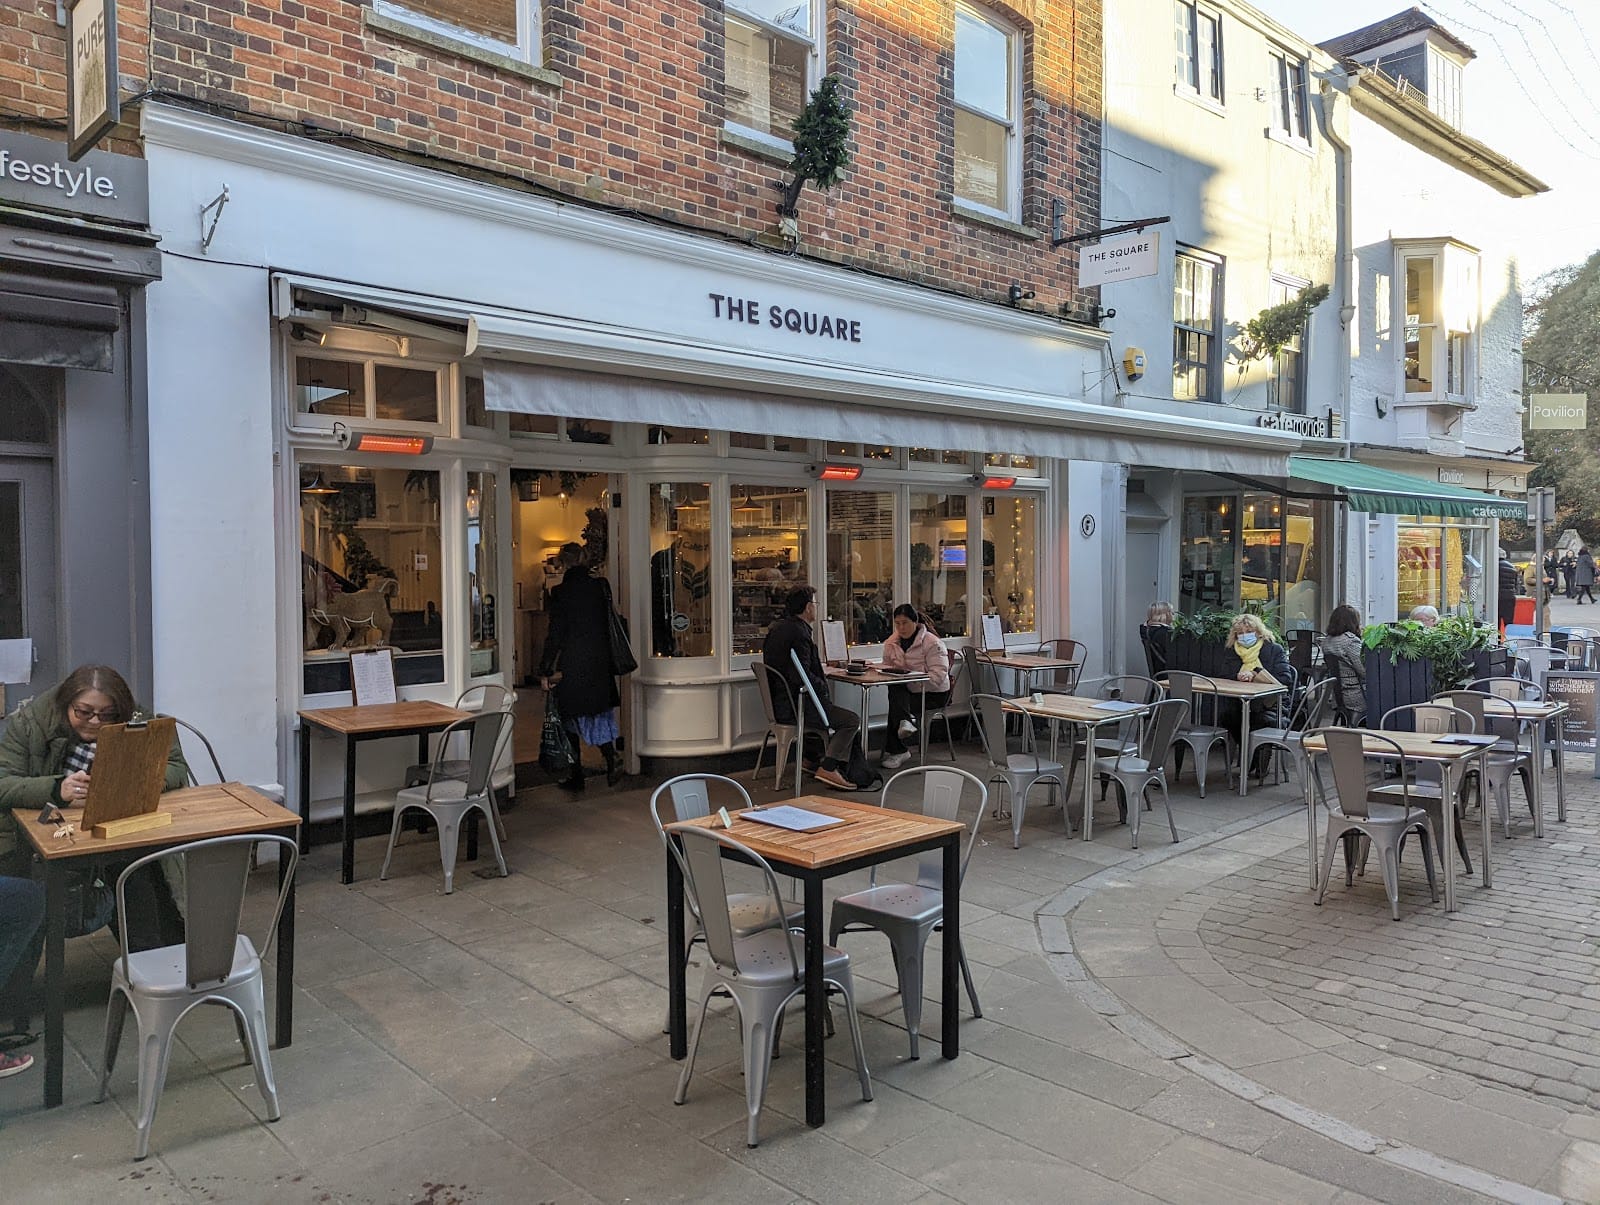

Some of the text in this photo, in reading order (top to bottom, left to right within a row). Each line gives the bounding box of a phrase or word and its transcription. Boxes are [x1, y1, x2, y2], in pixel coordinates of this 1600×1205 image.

[77, 11, 105, 69] PURE
[1088, 243, 1149, 263] THE SQUARE
[708, 293, 861, 343] THE SQUARE
[1533, 405, 1584, 419] Pavilion
[1439, 467, 1464, 484] Pavilion
